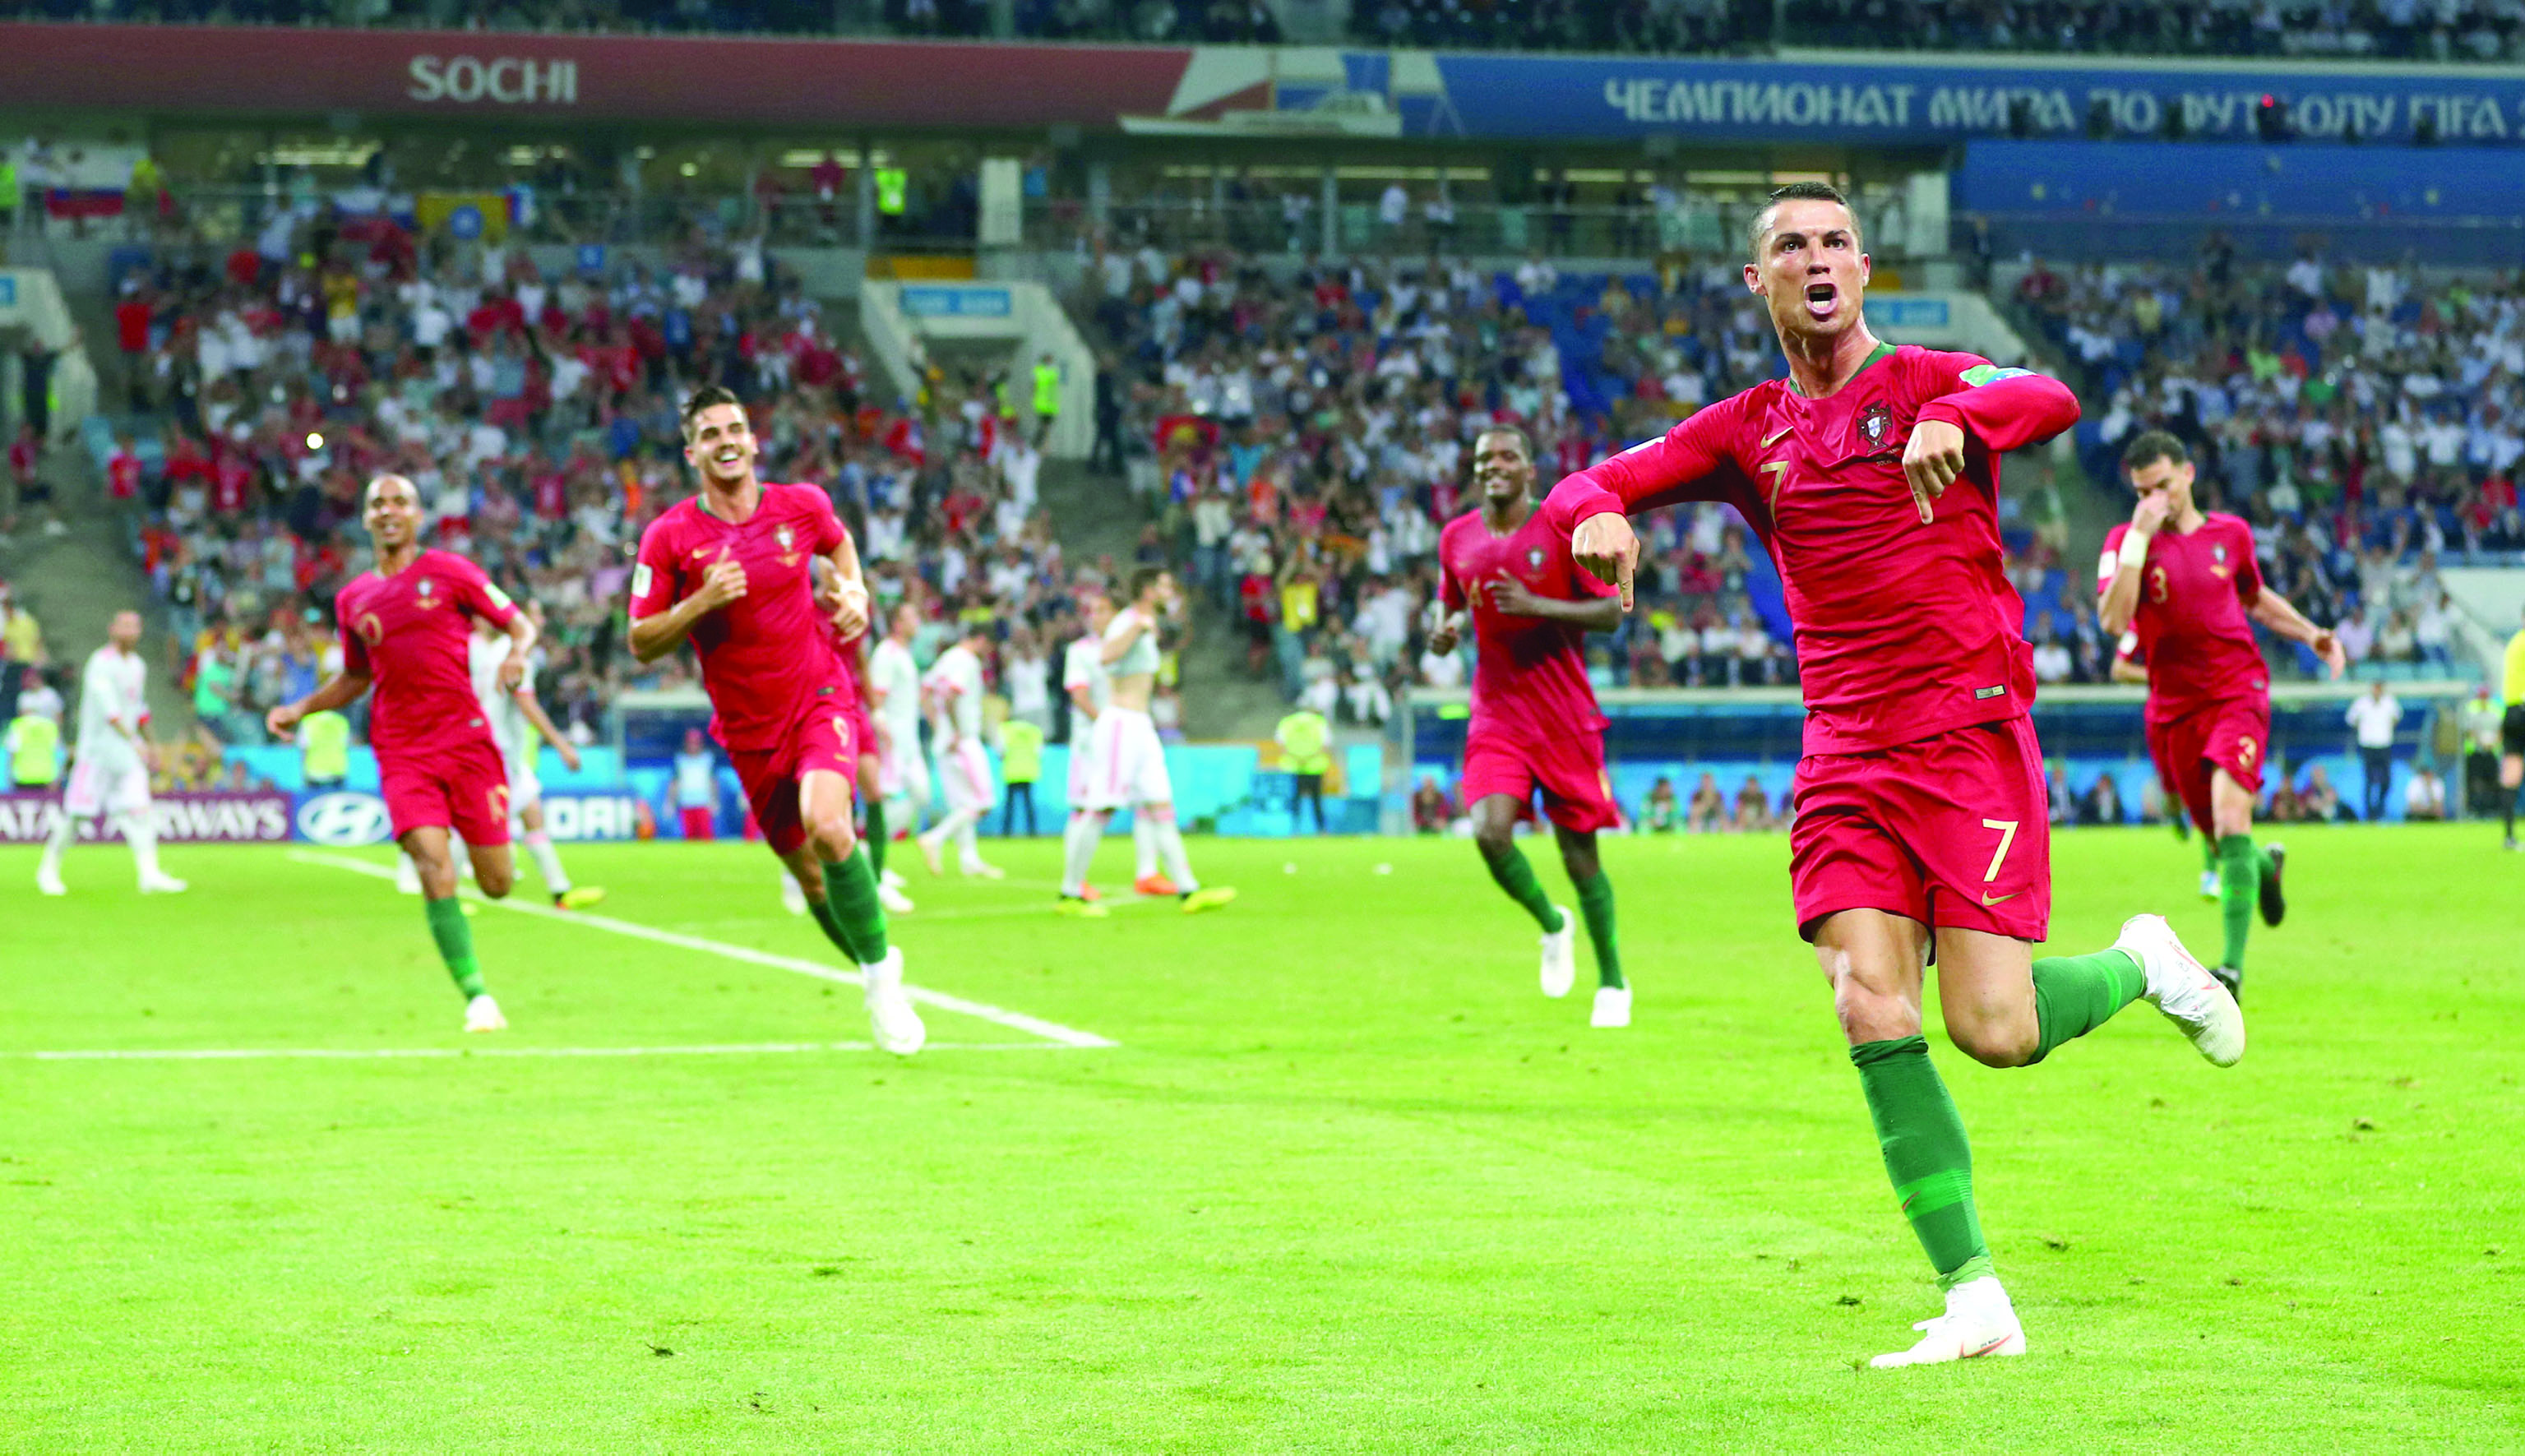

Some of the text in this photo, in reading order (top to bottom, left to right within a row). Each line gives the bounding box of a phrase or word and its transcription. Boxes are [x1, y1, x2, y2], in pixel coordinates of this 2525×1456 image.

[409, 54, 577, 104] SOCHI
[1605, 78, 1914, 126] ЧЕМПИОНАТ
[2171, 93, 2395, 136] ФУТОЛУ
[2409, 95, 2506, 139] FIFA
[1760, 460, 1789, 529] 7
[2151, 566, 2168, 604] 3
[832, 716, 849, 747] 9
[2238, 736, 2257, 770] 3
[1982, 819, 2019, 882] 7
